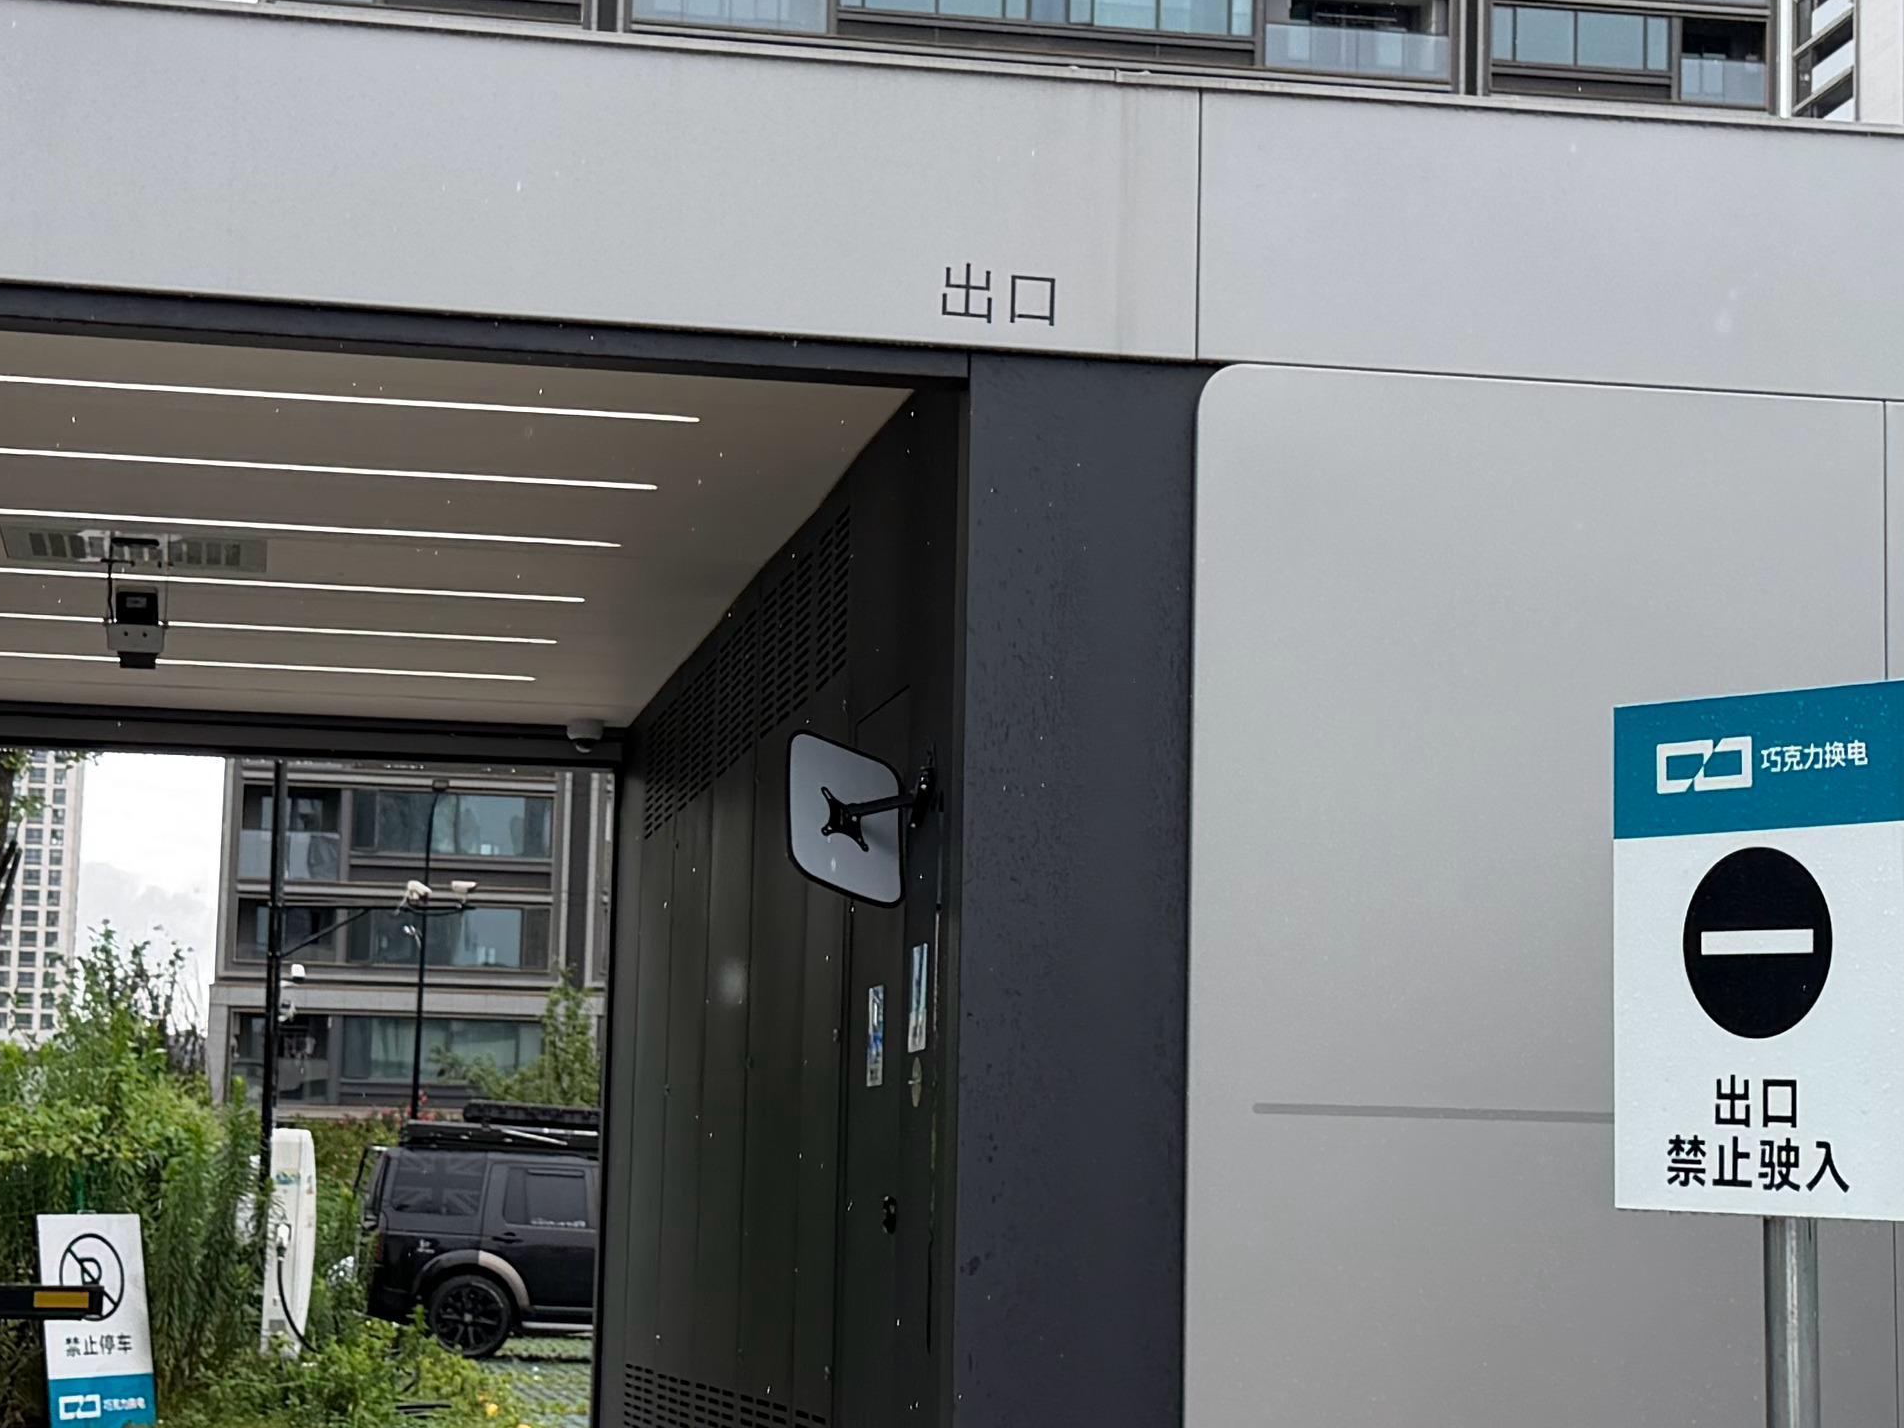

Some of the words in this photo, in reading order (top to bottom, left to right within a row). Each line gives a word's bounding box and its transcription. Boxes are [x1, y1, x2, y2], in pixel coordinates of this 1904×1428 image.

[941, 262, 1057, 327] 出口
[1760, 739, 1869, 773] 巧克力换电
[1713, 1073, 1798, 1130] 出口
[1666, 1134, 1850, 1193] 禁止驶入
[65, 1332, 132, 1357] 禁止停车
